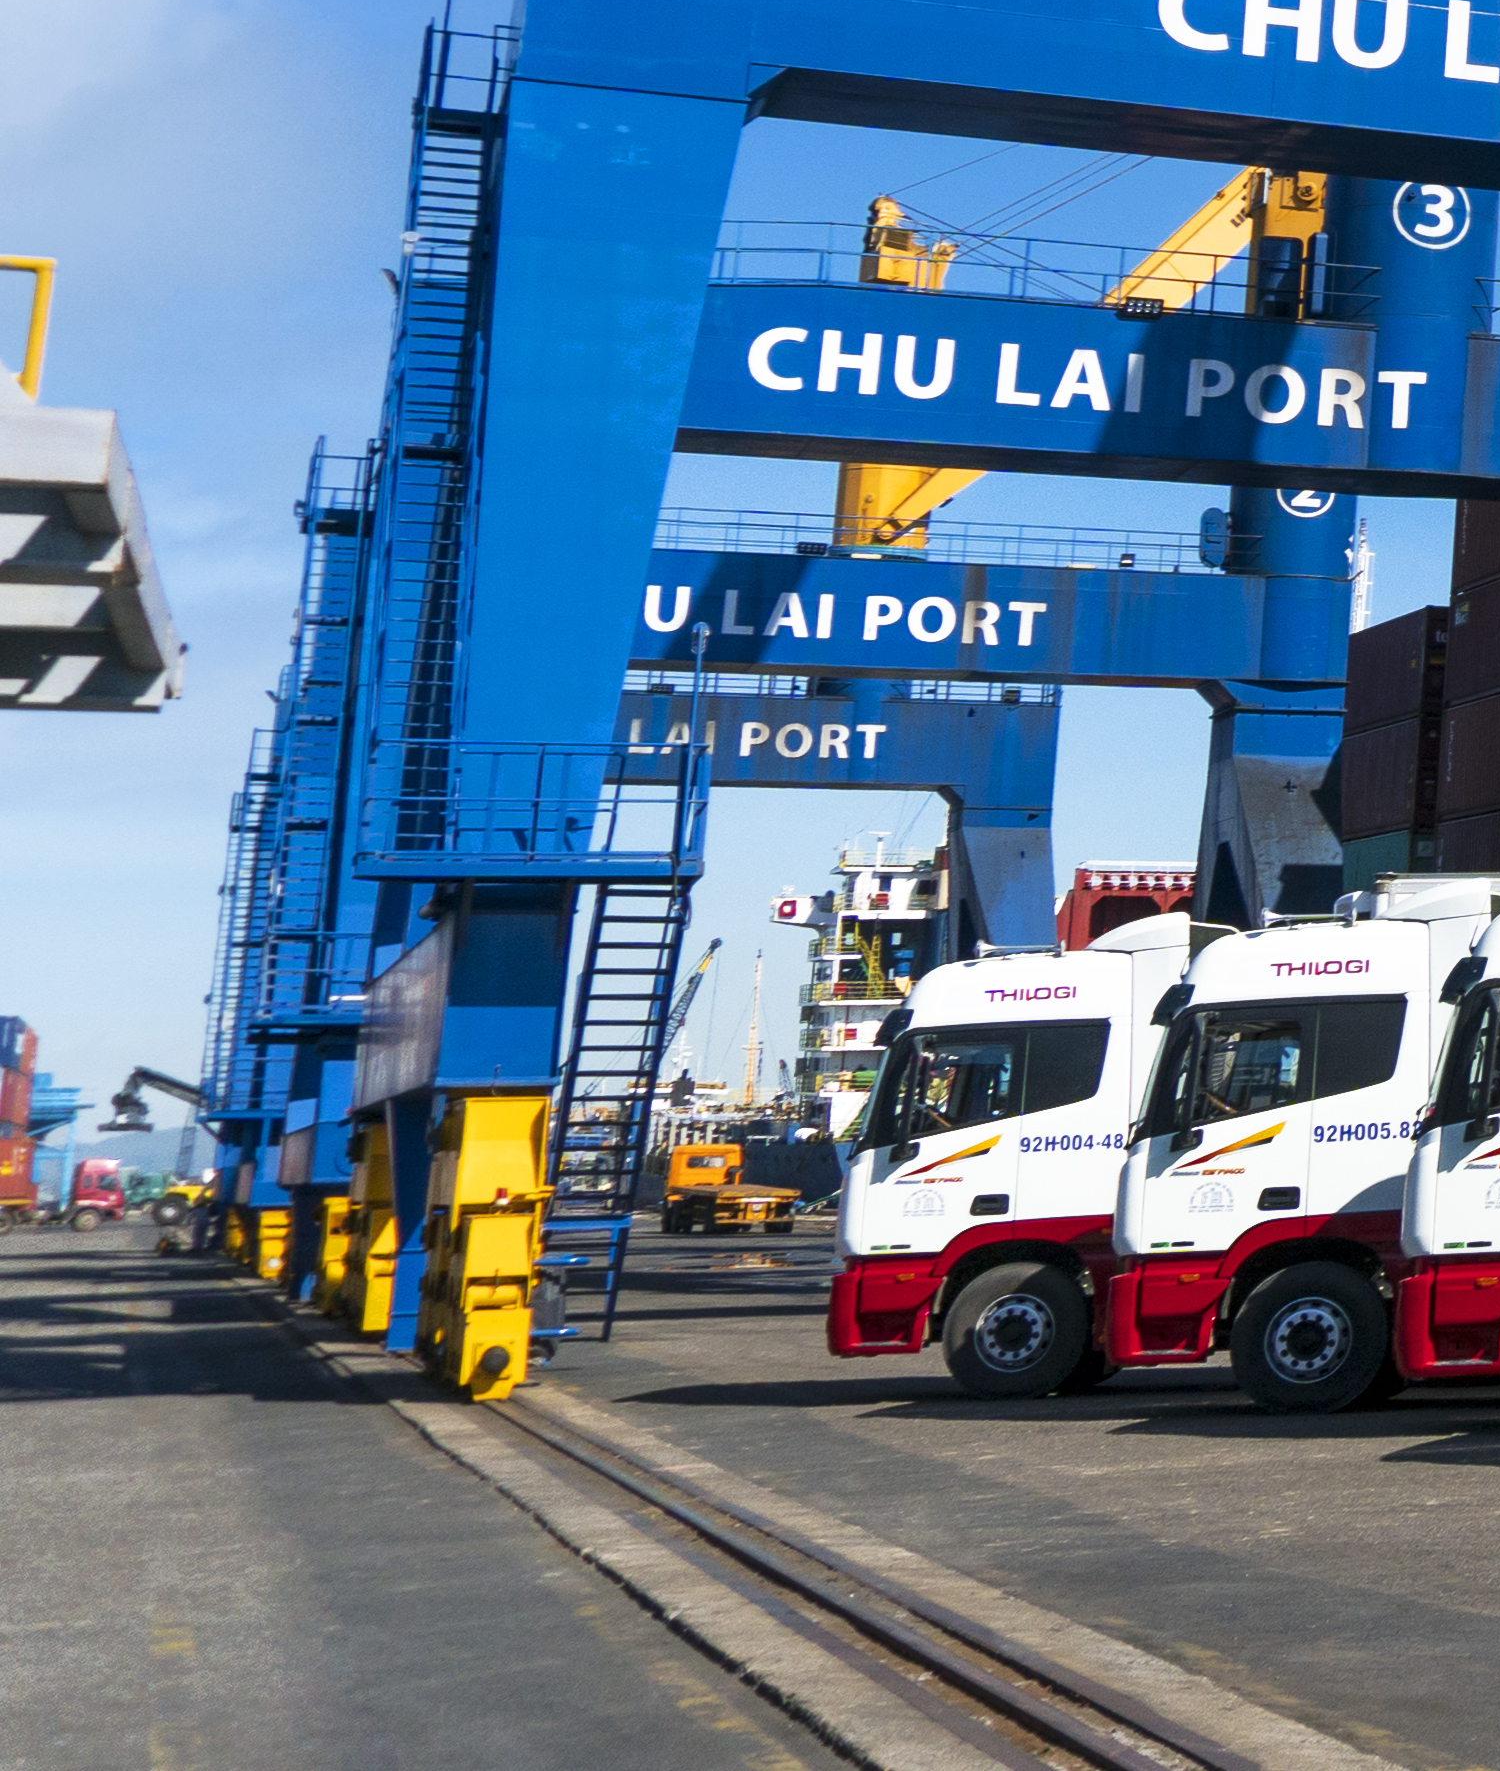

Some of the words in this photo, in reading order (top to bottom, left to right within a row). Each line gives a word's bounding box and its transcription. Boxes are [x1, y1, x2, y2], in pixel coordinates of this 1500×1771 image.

[1414, 184, 1455, 238] 3
[747, 326, 956, 400] CHU
[995, 342, 1143, 412] LAI
[1186, 358, 1428, 430] PORT
[722, 588, 835, 640] LAI
[862, 595, 1047, 647] PORT
[627, 718, 717, 756] LAI
[739, 721, 887, 759] PORT
[1270, 959, 1370, 977] THILOGI
[984, 986, 1077, 1003] THILOGI
